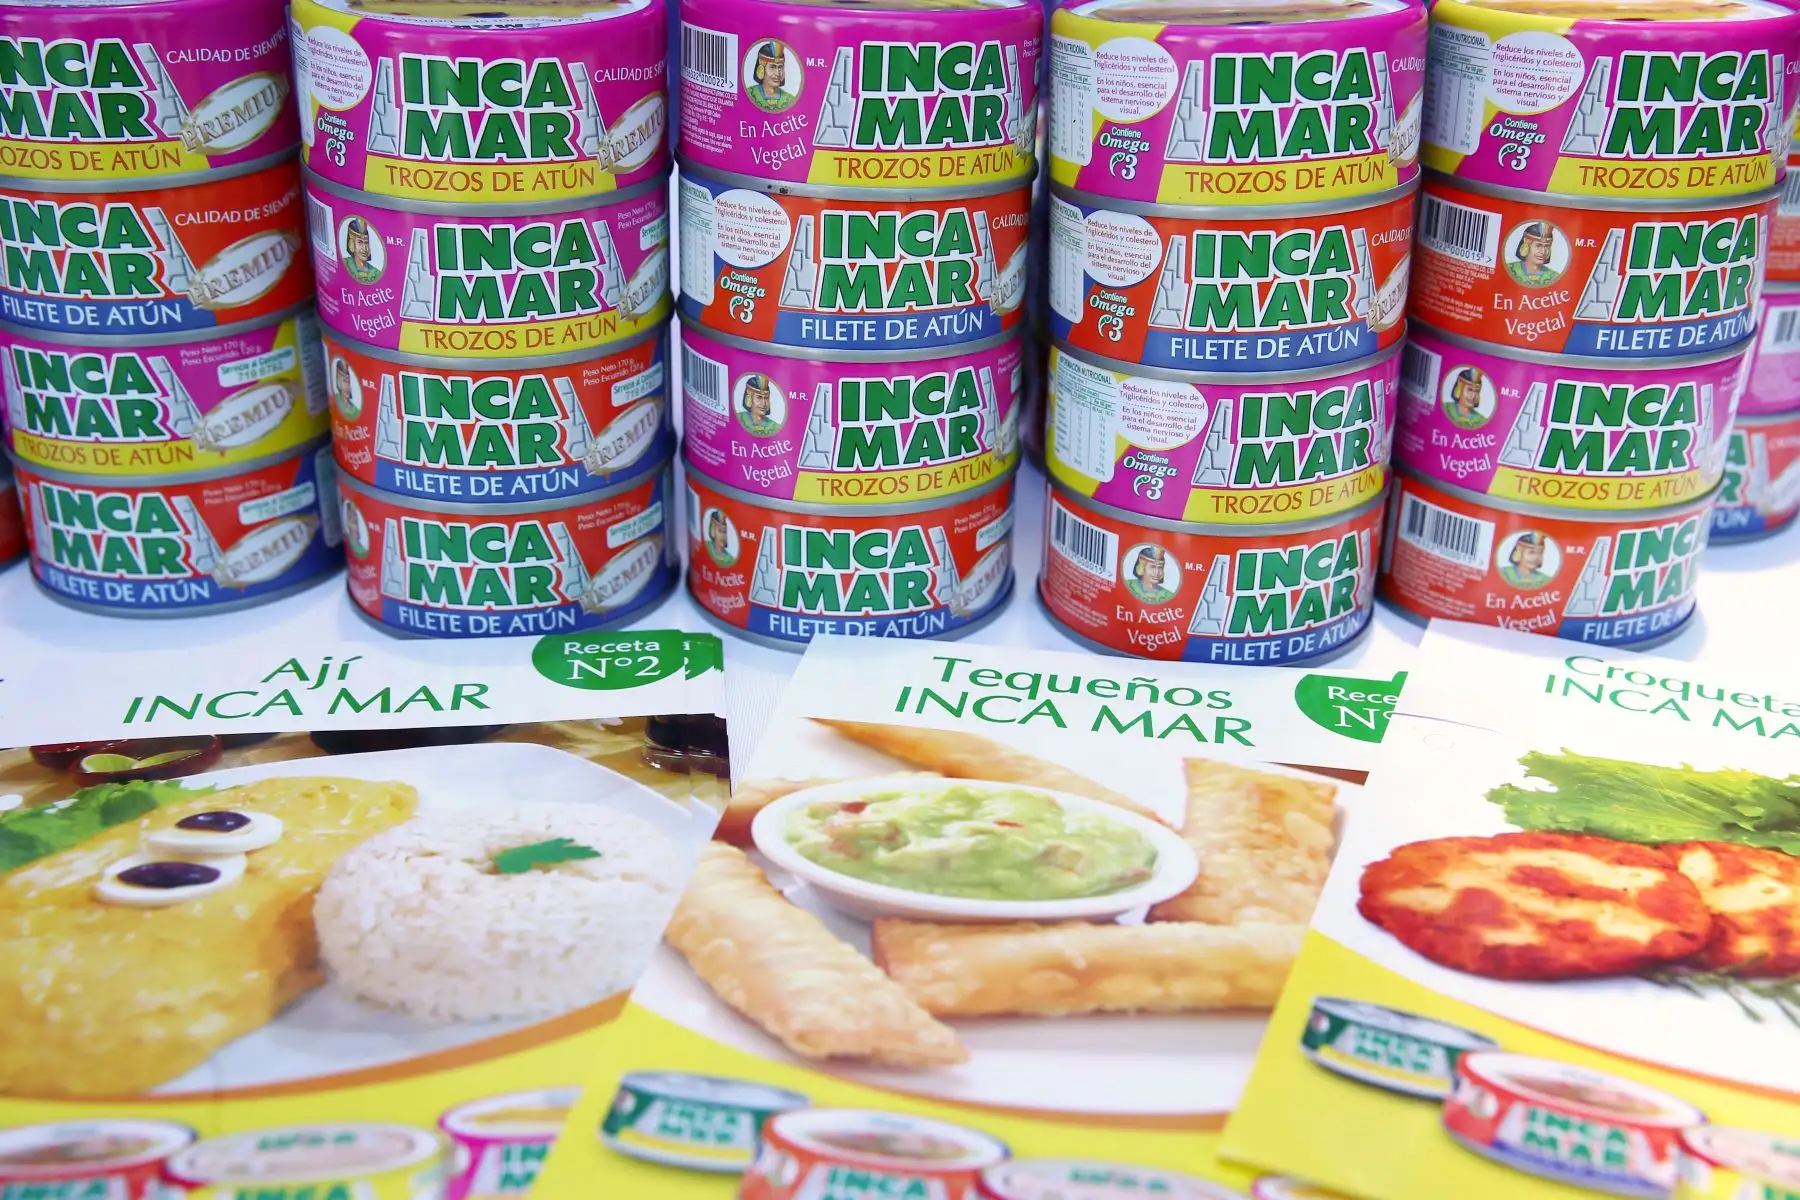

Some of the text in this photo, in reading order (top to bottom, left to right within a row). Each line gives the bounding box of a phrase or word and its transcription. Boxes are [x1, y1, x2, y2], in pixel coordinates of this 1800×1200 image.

[0, 40, 146, 88] NCA
[167, 49, 232, 64] CALIDAD
[235, 48, 251, 61] DE
[806, 57, 828, 69] M.R.
[862, 44, 1005, 91] INCA
[1492, 52, 1581, 68] Triglicéridos y colesterol
[1496, 43, 1576, 59] Reduce los niveles de
[403, 58, 573, 107] INCA
[1213, 52, 1373, 104] INCA
[1493, 68, 1573, 83] En los niños, esencial
[1493, 78, 1570, 92] para el desarrollo del
[1497, 86, 1521, 97] sistema
[1524, 90, 1556, 100] nervioso
[1619, 53, 1768, 102] INCA
[0, 90, 152, 138] MAR
[856, 96, 1003, 146] MAR
[1517, 98, 1540, 107] visual.
[405, 111, 574, 158] MAR
[740, 114, 808, 138] En Aceite
[1207, 104, 1373, 159] MAR
[1490, 123, 1546, 145] Omega
[1505, 117, 1538, 130] Contiene
[1605, 106, 1763, 154] MAR
[70, 145, 181, 171] DE ATÚN
[751, 137, 807, 171] Vegetal
[834, 148, 1014, 179] TROZOS DE ATÚN
[1511, 145, 1531, 170] 3
[1579, 158, 1767, 188] TROZOS DE ATÚN
[384, 163, 595, 192] TROZOS DE ATÚN
[1184, 156, 1385, 194] TROZOS DE ATÚN
[0, 199, 152, 248] INCA
[386, 236, 406, 247] M.R.
[823, 212, 975, 258] INCA
[1575, 238, 1597, 248] M.R.
[1630, 218, 1756, 268] INCA
[436, 222, 596, 270] INCA
[1194, 228, 1351, 278] INCA
[6, 246, 160, 295] MAR
[721, 275, 766, 299] Omega
[731, 271, 757, 285] Contiene
[819, 261, 975, 309] MAR
[2, 295, 181, 325] FILETE DE ATÚN
[341, 287, 394, 307] En Aceite
[439, 268, 599, 318] MAR
[740, 298, 755, 324] 3
[1188, 276, 1349, 328] MAR
[1494, 290, 1570, 311] En Aceite
[1618, 264, 1751, 318] MAR
[352, 308, 396, 338] Vegetal
[420, 315, 616, 351] TROZOS DE ATÚN
[801, 308, 983, 341] FILETE DE ATÚN
[1171, 324, 1360, 360] FILETE DE ATÚN
[1505, 312, 1566, 341] Vegetal
[1596, 311, 1748, 350] FILETE DE ATÚN
[12, 347, 156, 395] INCA
[23, 393, 170, 437] MAR
[401, 375, 558, 419] INCA
[840, 370, 980, 421] INCA
[1241, 383, 1373, 438] INCA
[1552, 383, 1696, 425] INCA
[21, 437, 193, 466] TROZOS DE ATÚN
[405, 422, 561, 466] MAR
[837, 417, 979, 467] MAR
[1233, 433, 1369, 485] MAR
[1538, 428, 1691, 472] MAR
[395, 469, 579, 496] FILETE DE ATÚN
[817, 458, 992, 497] TROZOS DE ATÚN
[1210, 471, 1378, 514] TROZOS DE ATÚN
[1515, 471, 1697, 499] TROZOS DE ATÚN
[41, 485, 181, 532] INCA
[52, 529, 192, 574] MAR
[404, 520, 553, 563] INCA
[784, 527, 930, 569] INCA
[1236, 535, 1358, 591] INCA
[50, 574, 210, 602] FILETE DE ATÚN
[408, 565, 560, 605] MAR
[782, 570, 929, 612] MAR
[1486, 591, 1560, 610] En Aceite
[399, 608, 575, 634] FILETE DE ATÚN
[769, 612, 945, 637] FILETE DE ATÚN
[1228, 580, 1356, 635] MAR
[1583, 612, 1672, 641] FILETE DE
[564, 640, 660, 655] Receta
[1211, 615, 1361, 661] FILETE DE ATÚN
[260, 656, 363, 689] Ají
[932, 656, 1233, 710] Tequeños
[122, 683, 492, 723] INCA MAR
[895, 685, 1255, 747] INCA MAR
[1545, 674, 1690, 721] INCA
